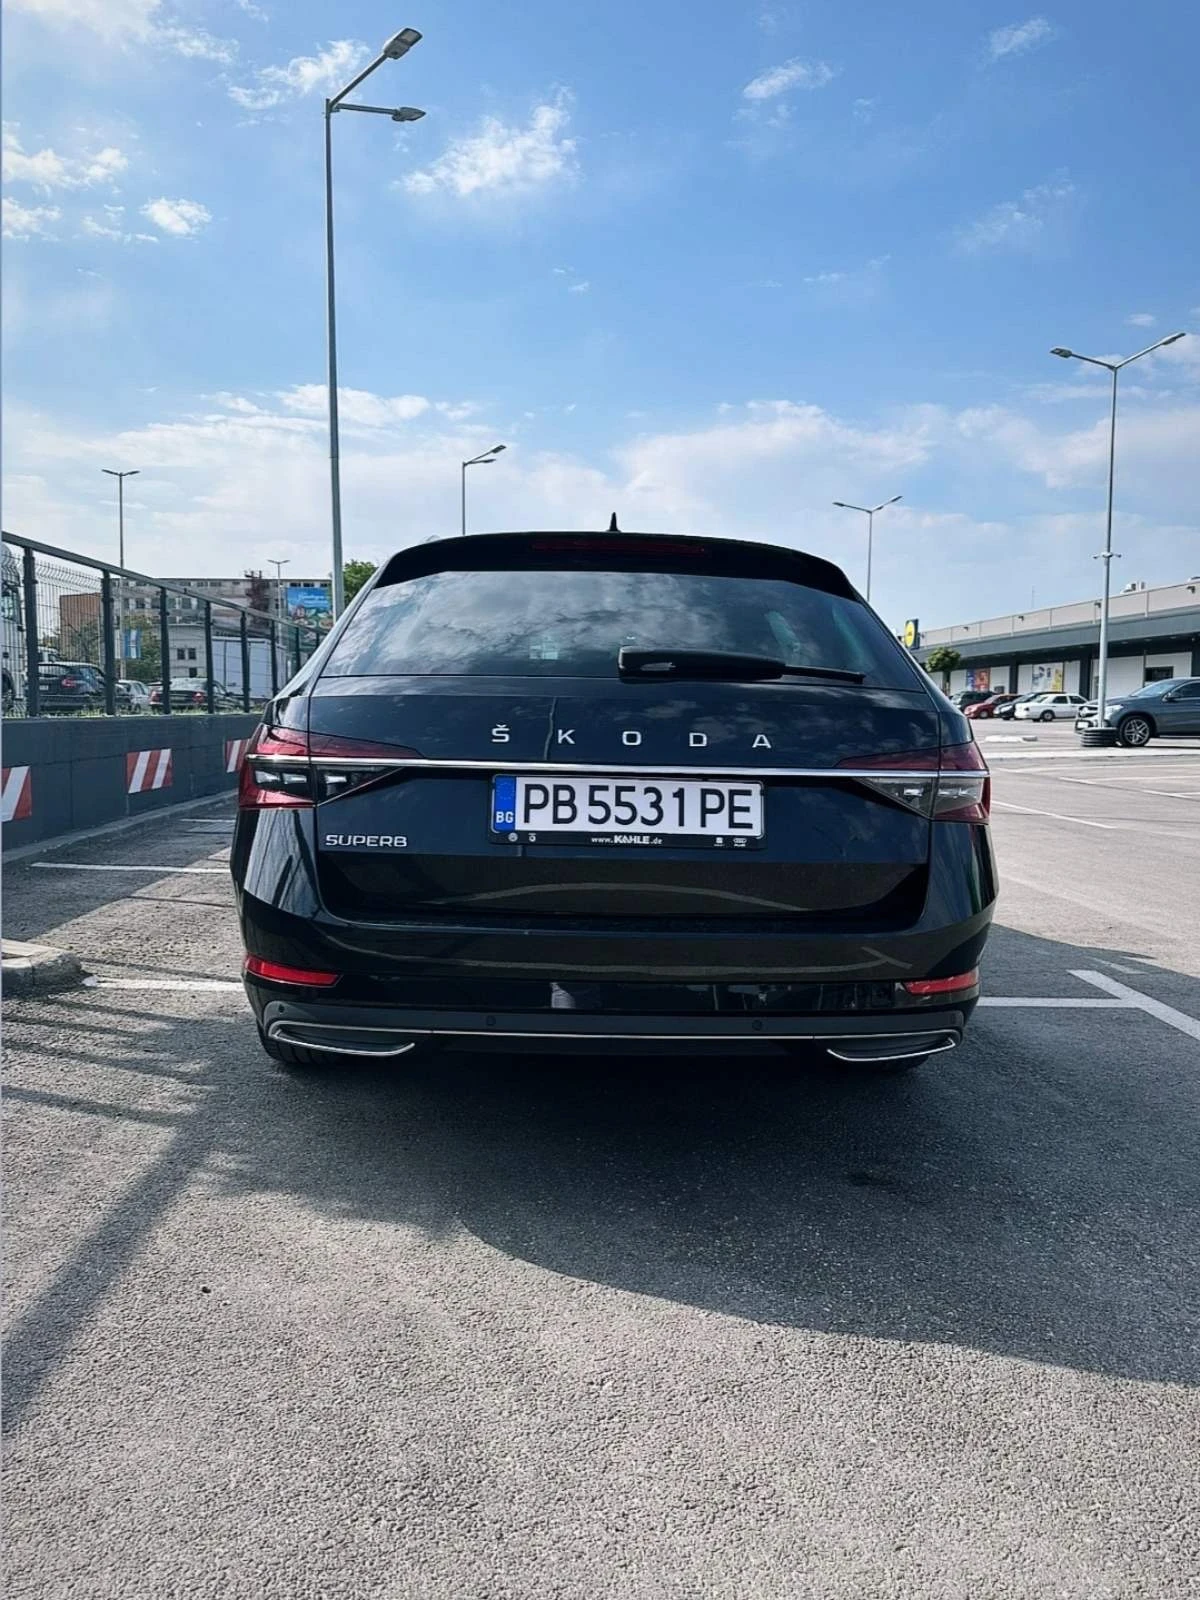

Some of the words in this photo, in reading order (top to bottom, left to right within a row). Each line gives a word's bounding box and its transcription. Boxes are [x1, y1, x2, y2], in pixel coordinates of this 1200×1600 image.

[491, 724, 772, 749] ŠKODA
[495, 810, 515, 824] BG
[325, 834, 408, 847] SUPERB
[591, 834, 663, 845] www.KAHLE.de
